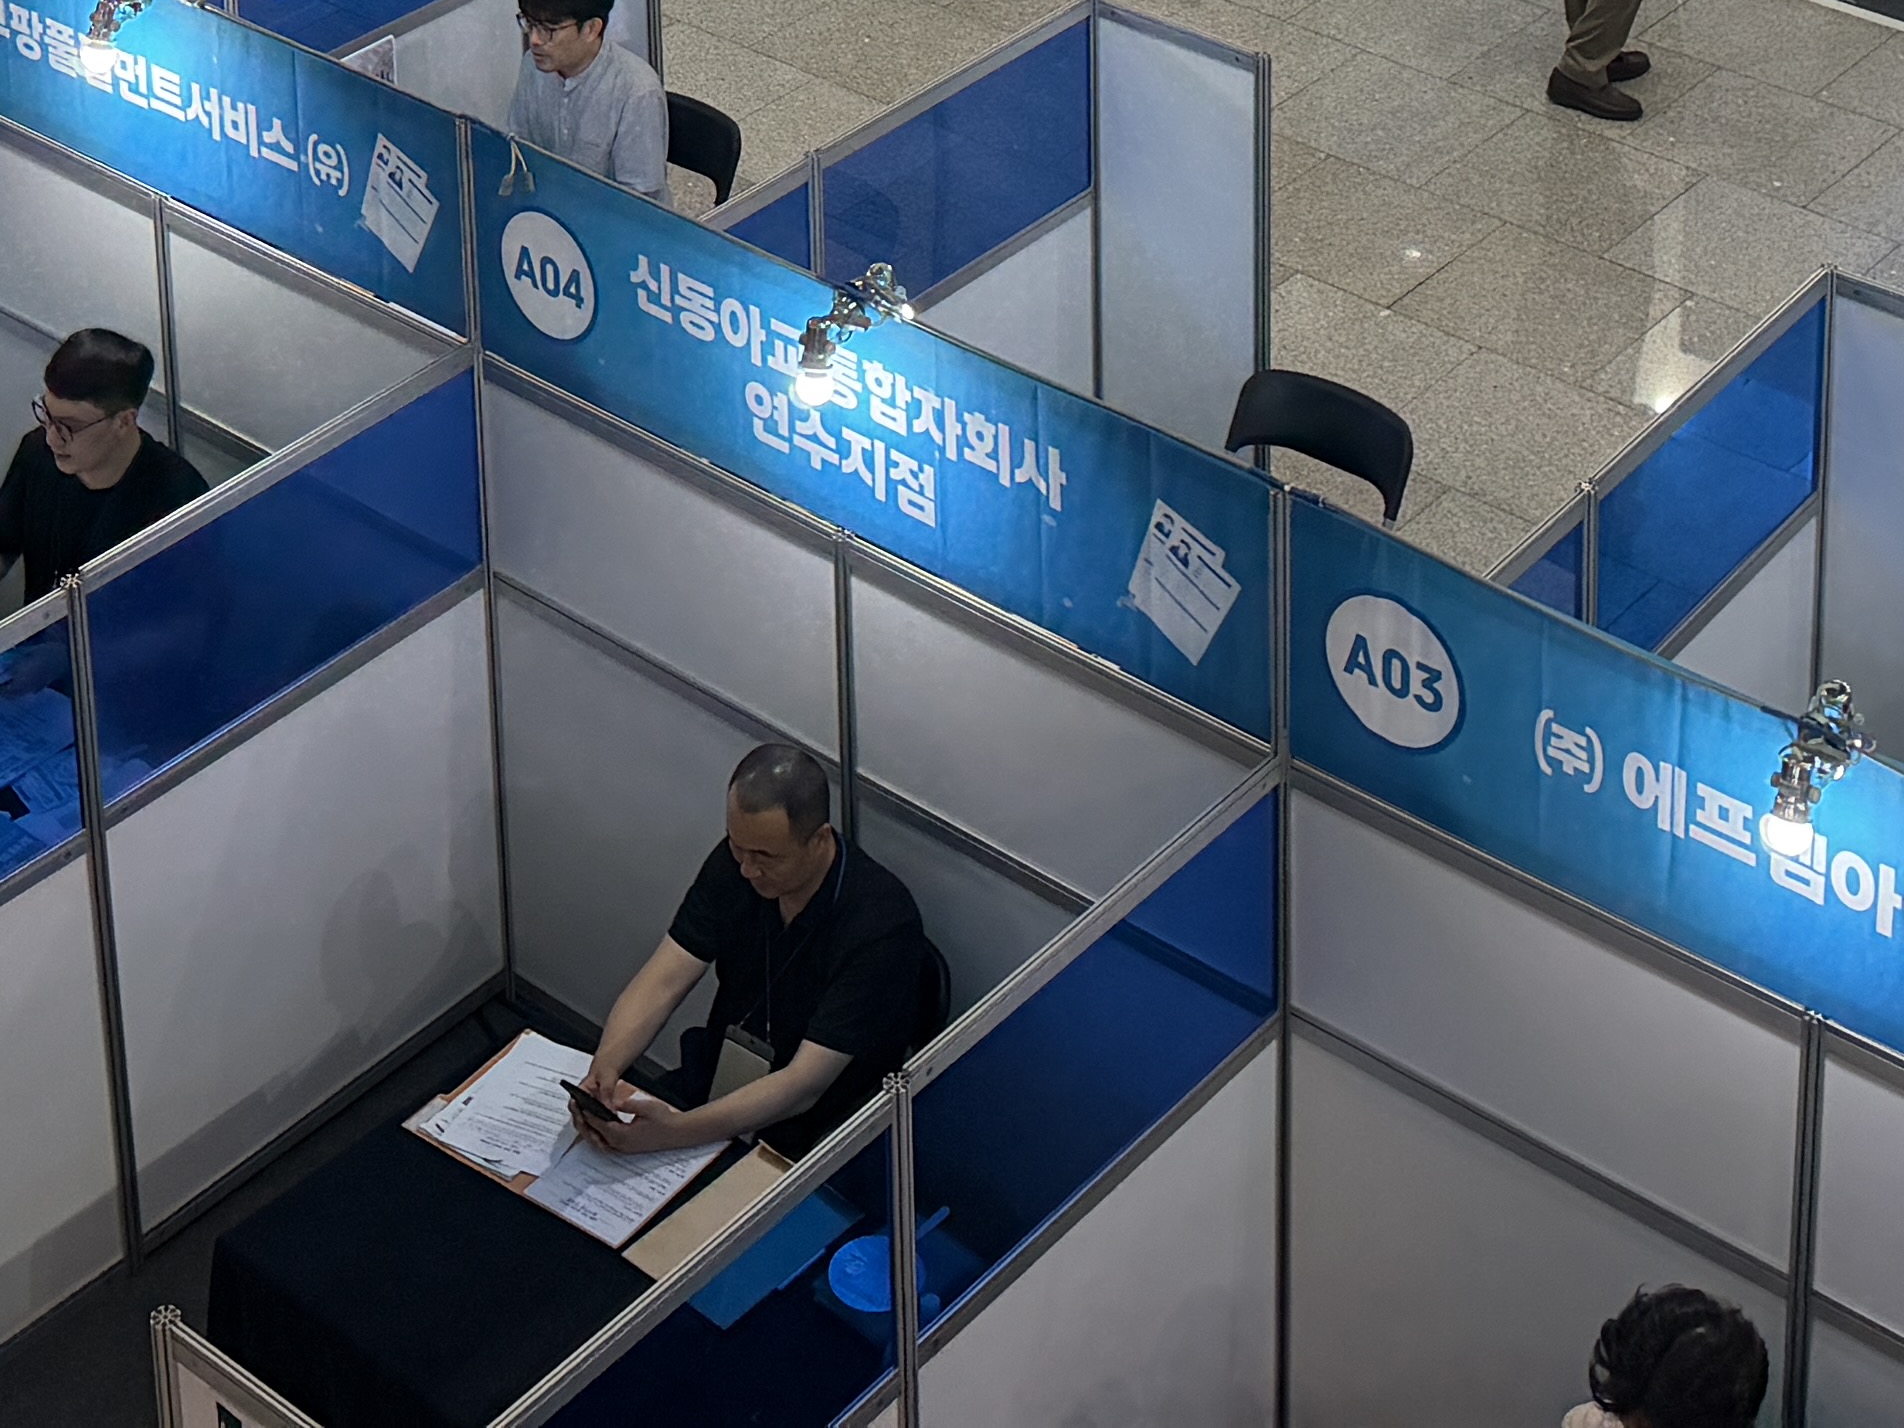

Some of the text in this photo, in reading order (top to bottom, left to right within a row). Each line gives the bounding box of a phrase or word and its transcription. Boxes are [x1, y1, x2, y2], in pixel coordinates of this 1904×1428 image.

[305, 132, 350, 197] (유)
[514, 245, 585, 312] A04
[744, 379, 939, 528] 연수지점
[1342, 632, 1444, 714] A03
[1533, 707, 1604, 794] (주)
